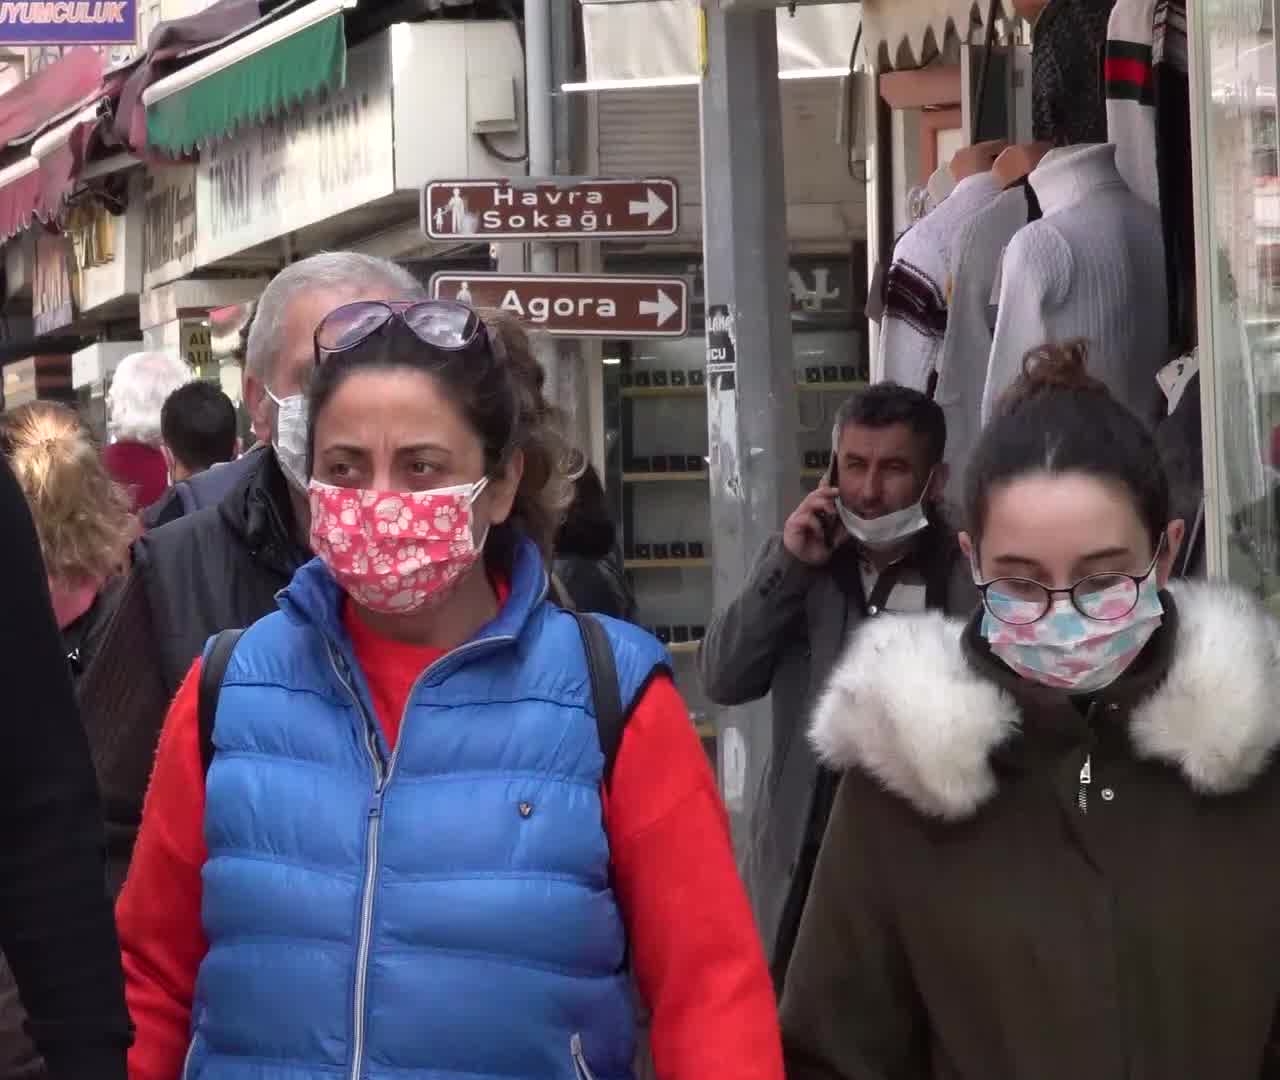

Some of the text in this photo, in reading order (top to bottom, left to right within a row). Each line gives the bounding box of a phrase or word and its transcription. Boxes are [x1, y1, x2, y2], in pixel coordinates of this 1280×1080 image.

[493, 187, 603, 206] Havra
[483, 210, 613, 231] Sokağı
[500, 290, 617, 323] Agora
